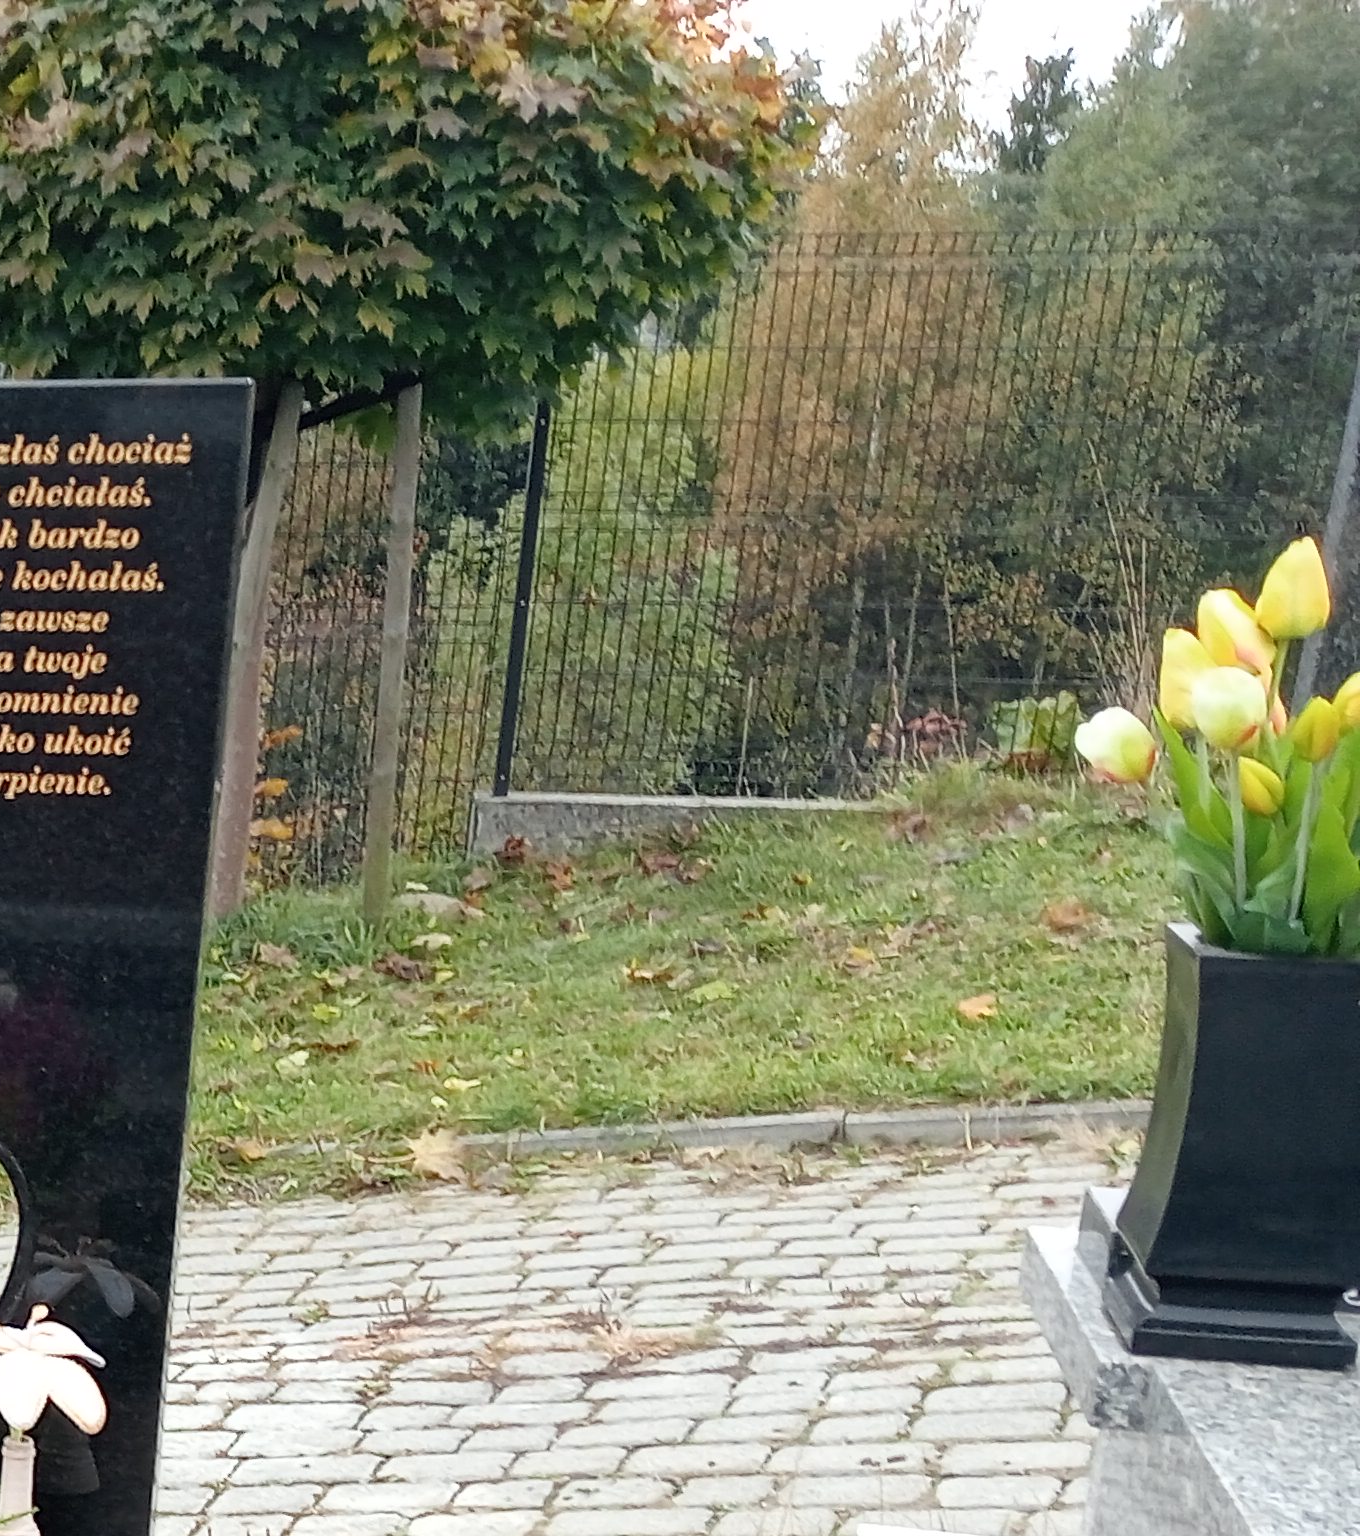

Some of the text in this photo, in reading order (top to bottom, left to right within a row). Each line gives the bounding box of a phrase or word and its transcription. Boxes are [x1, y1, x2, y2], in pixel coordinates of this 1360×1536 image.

[66, 432, 193, 465] chociaż
[7, 475, 153, 508] chciałaś.
[27, 518, 141, 550] bardzo
[11, 559, 165, 592] kochałaś.
[22, 643, 109, 680] twoje
[43, 725, 133, 757] ukoić
